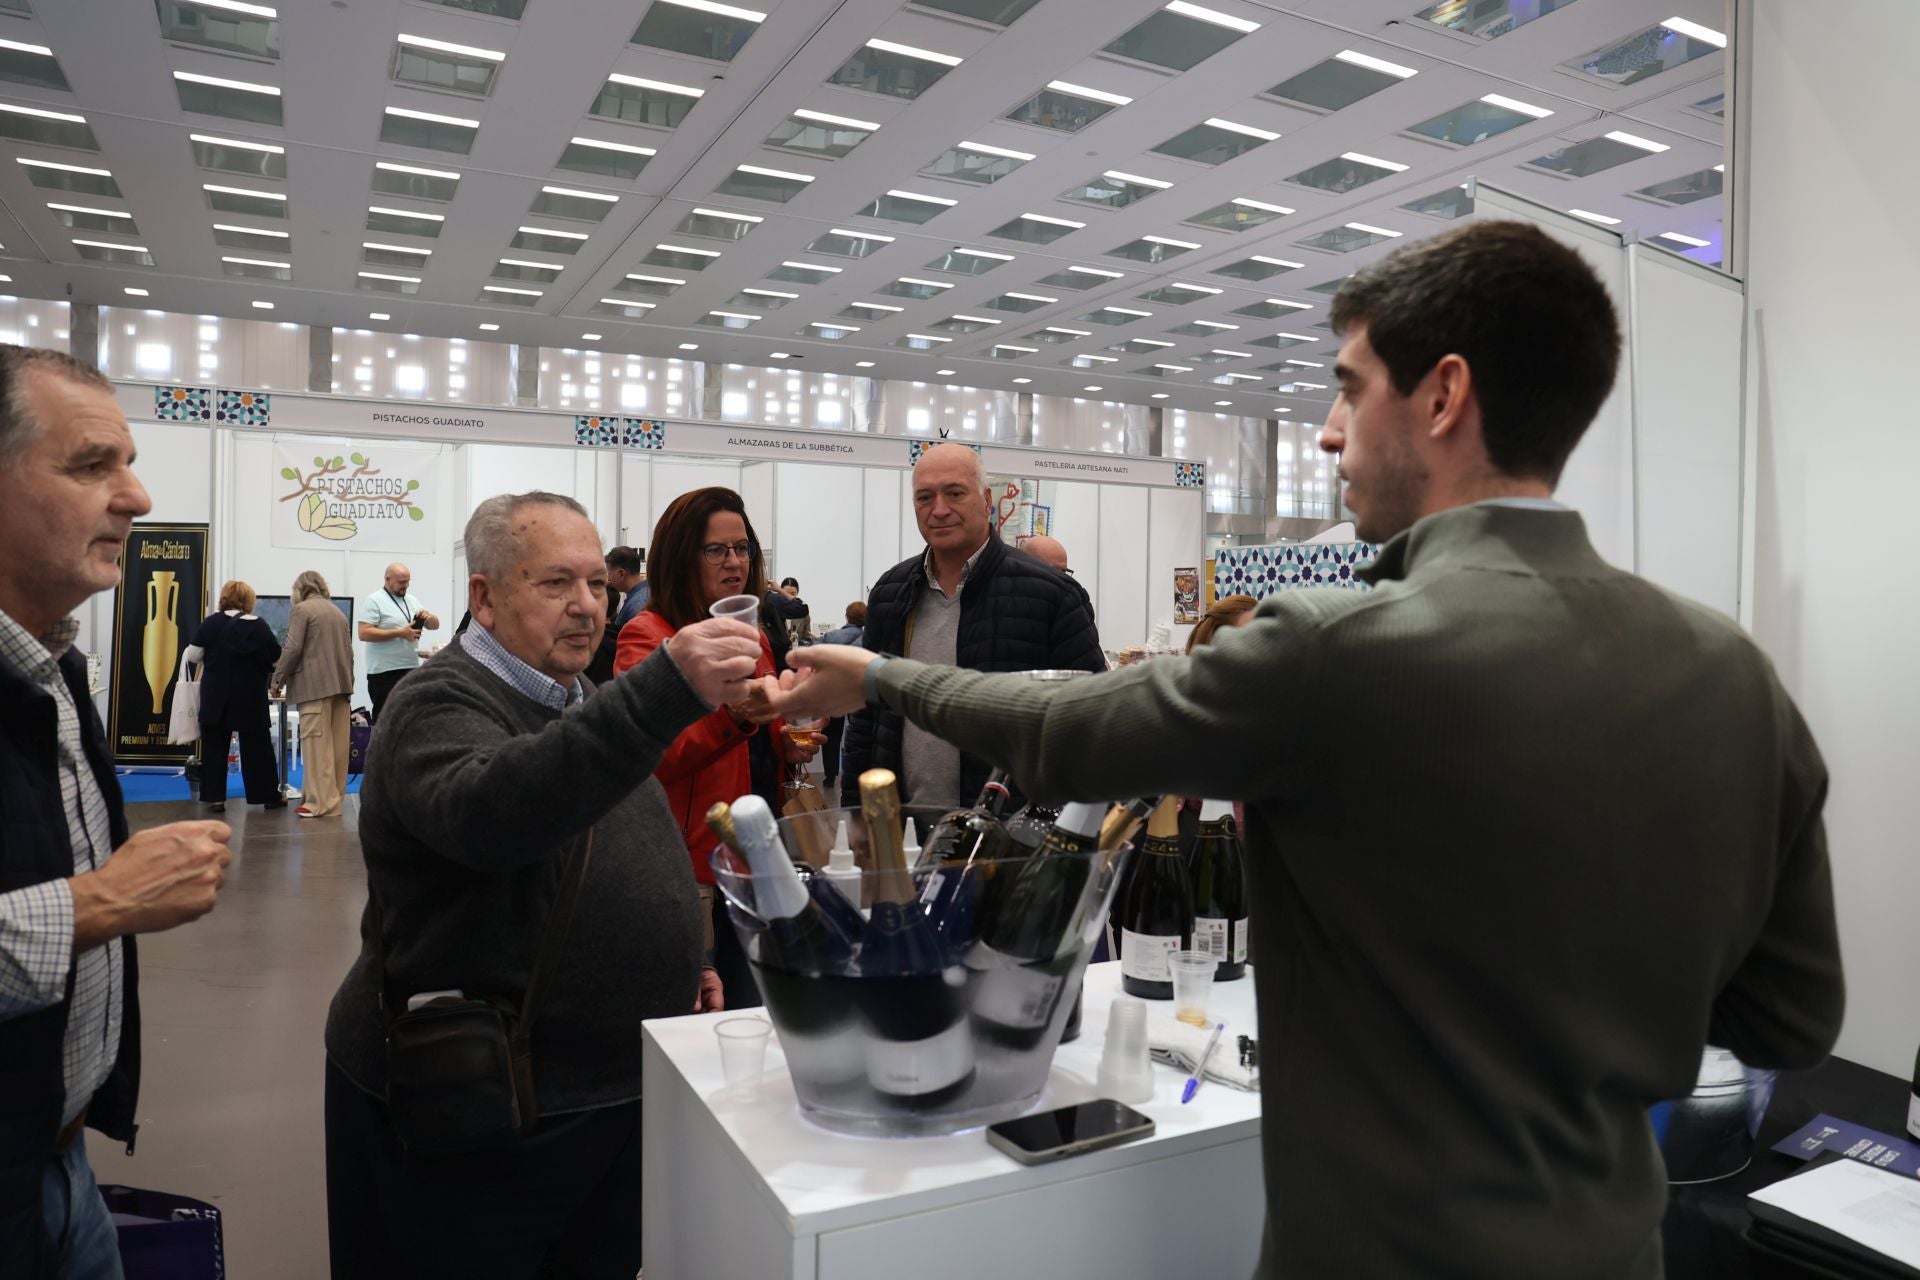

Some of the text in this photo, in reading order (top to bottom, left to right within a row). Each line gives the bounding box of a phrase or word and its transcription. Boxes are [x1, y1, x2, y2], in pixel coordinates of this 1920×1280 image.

[373, 413, 484, 428] PISTACHOS GUADIATO
[727, 438, 781, 448] ALMAZARAS
[809, 443, 854, 453] SUBBÉTICA
[317, 478, 403, 495] PISTACHOS
[329, 503, 404, 519] GUADIATO
[140, 540, 159, 559] Alma
[121, 736, 149, 744] PREMIUM
